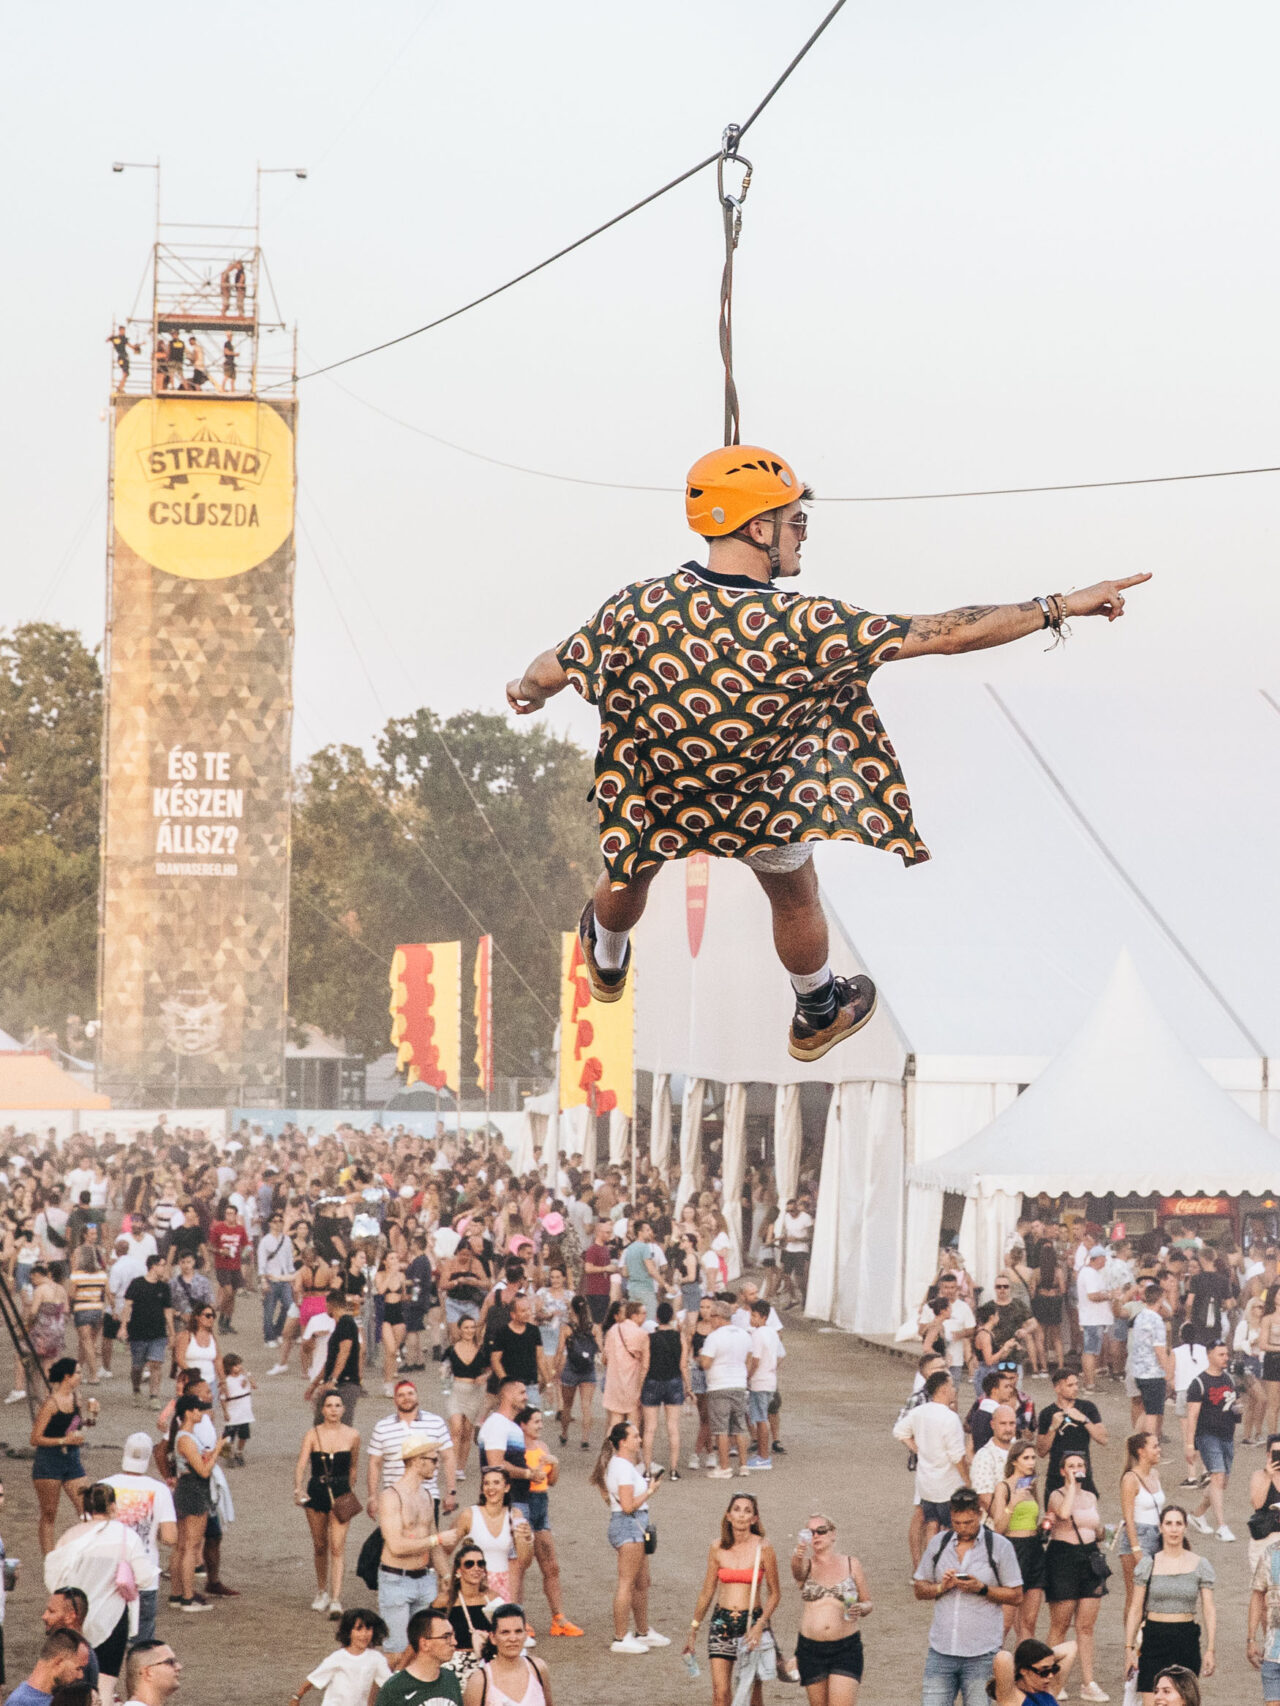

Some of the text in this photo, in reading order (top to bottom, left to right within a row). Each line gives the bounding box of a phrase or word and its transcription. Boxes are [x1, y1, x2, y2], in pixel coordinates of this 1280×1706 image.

[149, 447, 261, 476] STRAND
[149, 493, 260, 527] CSÚSZDA
[168, 745, 231, 781] ÉS TE
[153, 782, 243, 818] KÉSZEN
[156, 818, 239, 855] ÁLLSZ?
